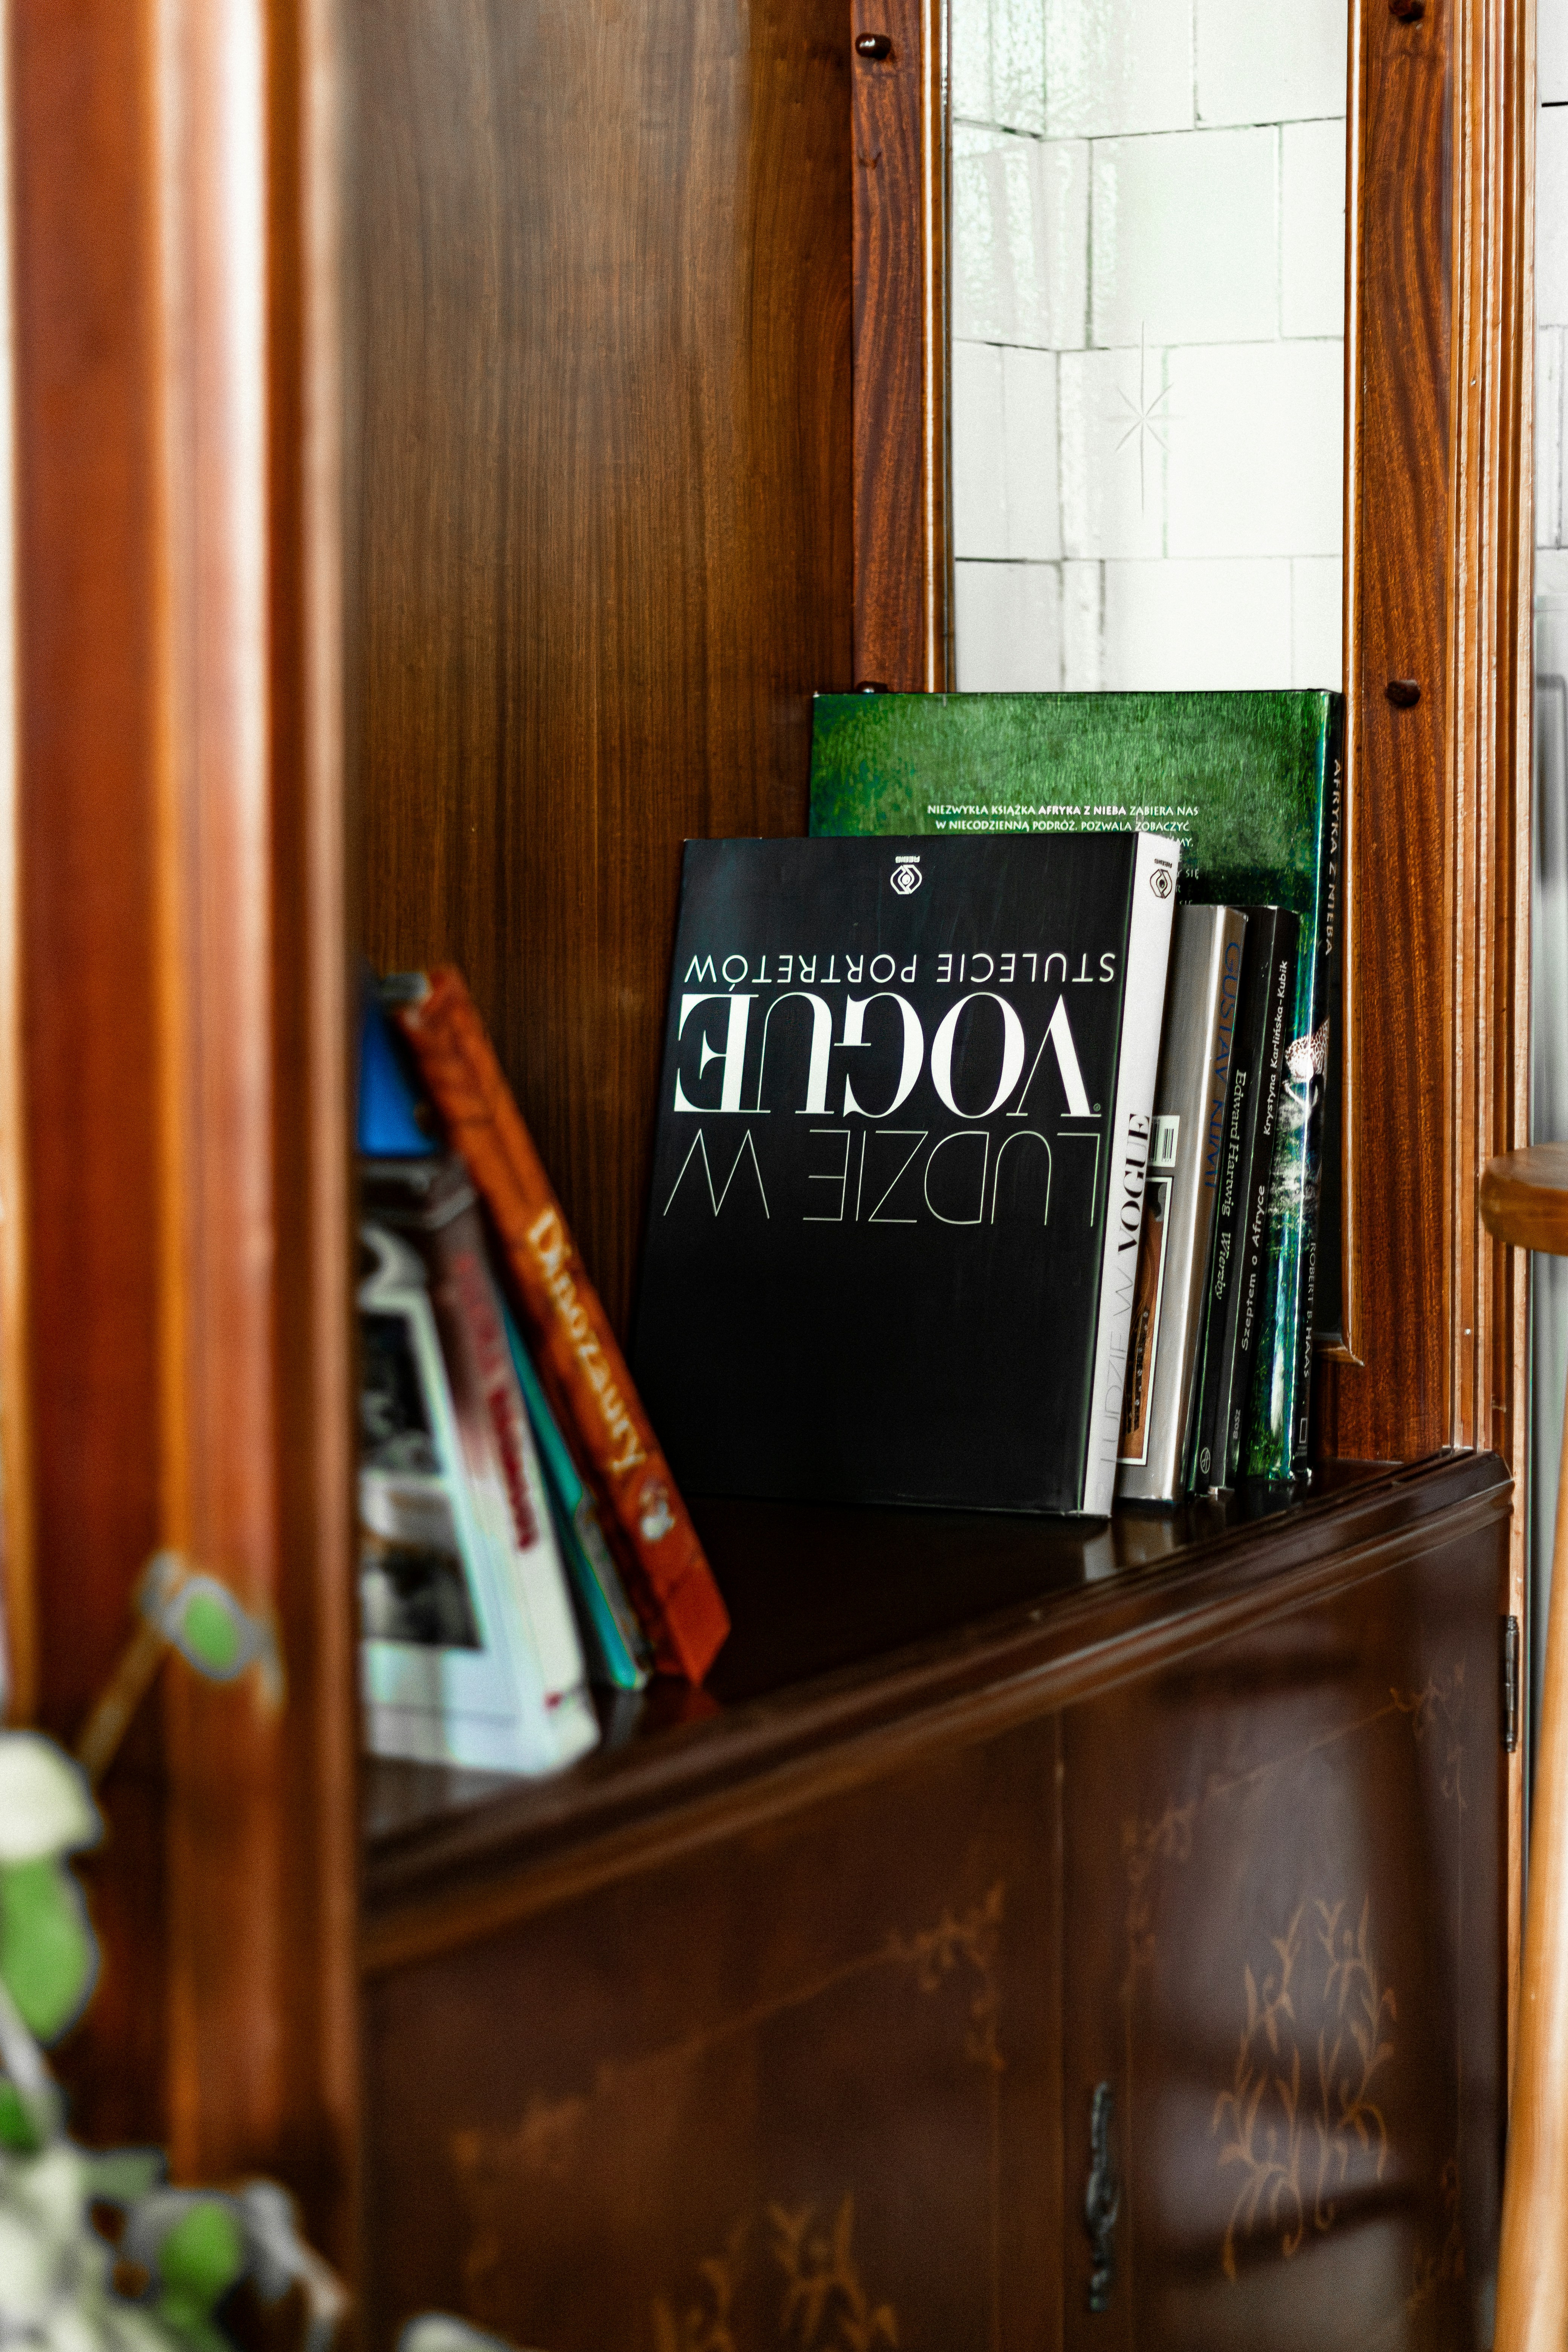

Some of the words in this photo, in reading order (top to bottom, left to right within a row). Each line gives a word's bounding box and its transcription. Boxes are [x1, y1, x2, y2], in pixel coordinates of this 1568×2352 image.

[927, 805, 989, 815] NIEZWYKŁA
[991, 804, 1036, 816] KSIĄŻKA
[1038, 805, 1081, 815] AFRYKA
[1084, 806, 1090, 815] Z
[1093, 806, 1126, 815] NIEBA
[1130, 806, 1174, 816] ZABIERA
[1177, 806, 1199, 816] NAS
[935, 820, 946, 829] W
[949, 820, 1029, 832] NIECODZIENNĄ
[1081, 821, 1132, 831] POZWALA
[1135, 820, 1190, 831] ZOBACZYĆ
[1331, 759, 1341, 854] AFRYKA
[1329, 861, 1337, 877] Z
[1326, 884, 1335, 956] NIEBA
[684, 954, 916, 992] PORTRETÓW
[937, 953, 1116, 983] STULECIE
[1214, 942, 1240, 1083] GUSTAV
[673, 992, 1102, 1118] VOGUE
[1229, 1069, 1246, 1145] Edward
[1263, 1074, 1276, 1135] Krystyna
[663, 1129, 770, 1219] W
[802, 1130, 1101, 1227] LUDZIE
[1118, 1113, 1150, 1256] VOGUE
[1221, 1145, 1238, 1217] Hartwig
[1252, 1185, 1265, 1247] Afryce
[1113, 1267, 1134, 1317] W
[1252, 1255, 1257, 1266] o
[1307, 1242, 1316, 1306] ROBERT
[1241, 1273, 1256, 1351] Szeptem
[1304, 1327, 1312, 1378] HAAS
